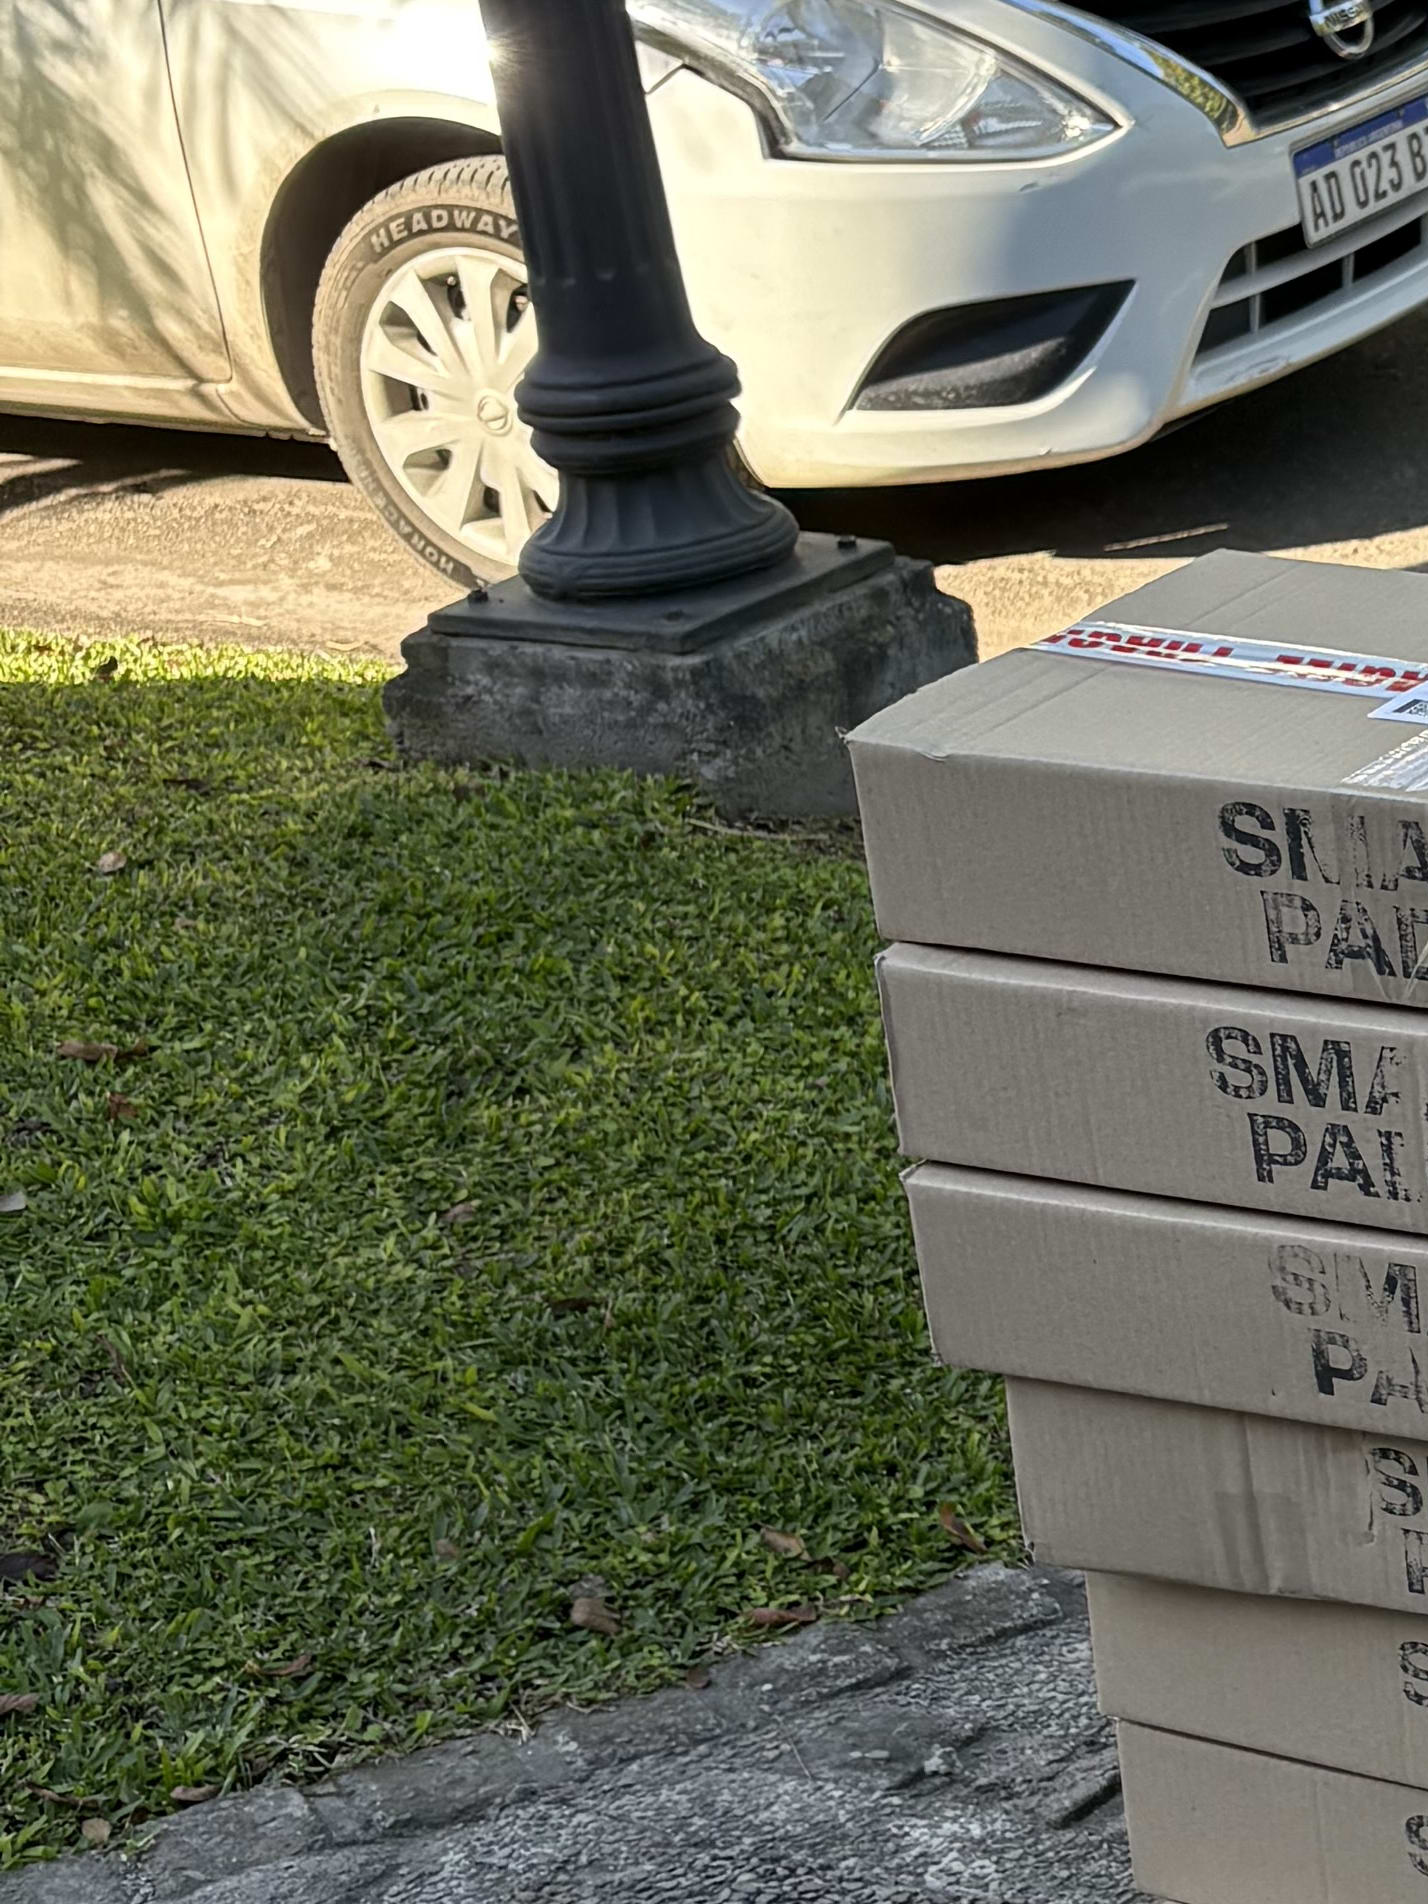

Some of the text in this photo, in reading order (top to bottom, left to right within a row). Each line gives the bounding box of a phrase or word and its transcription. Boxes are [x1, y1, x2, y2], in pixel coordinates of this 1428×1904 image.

[1309, 170, 1345, 232] AD
[1350, 141, 1403, 209] 023
[369, 209, 519, 254] HEADWAY
